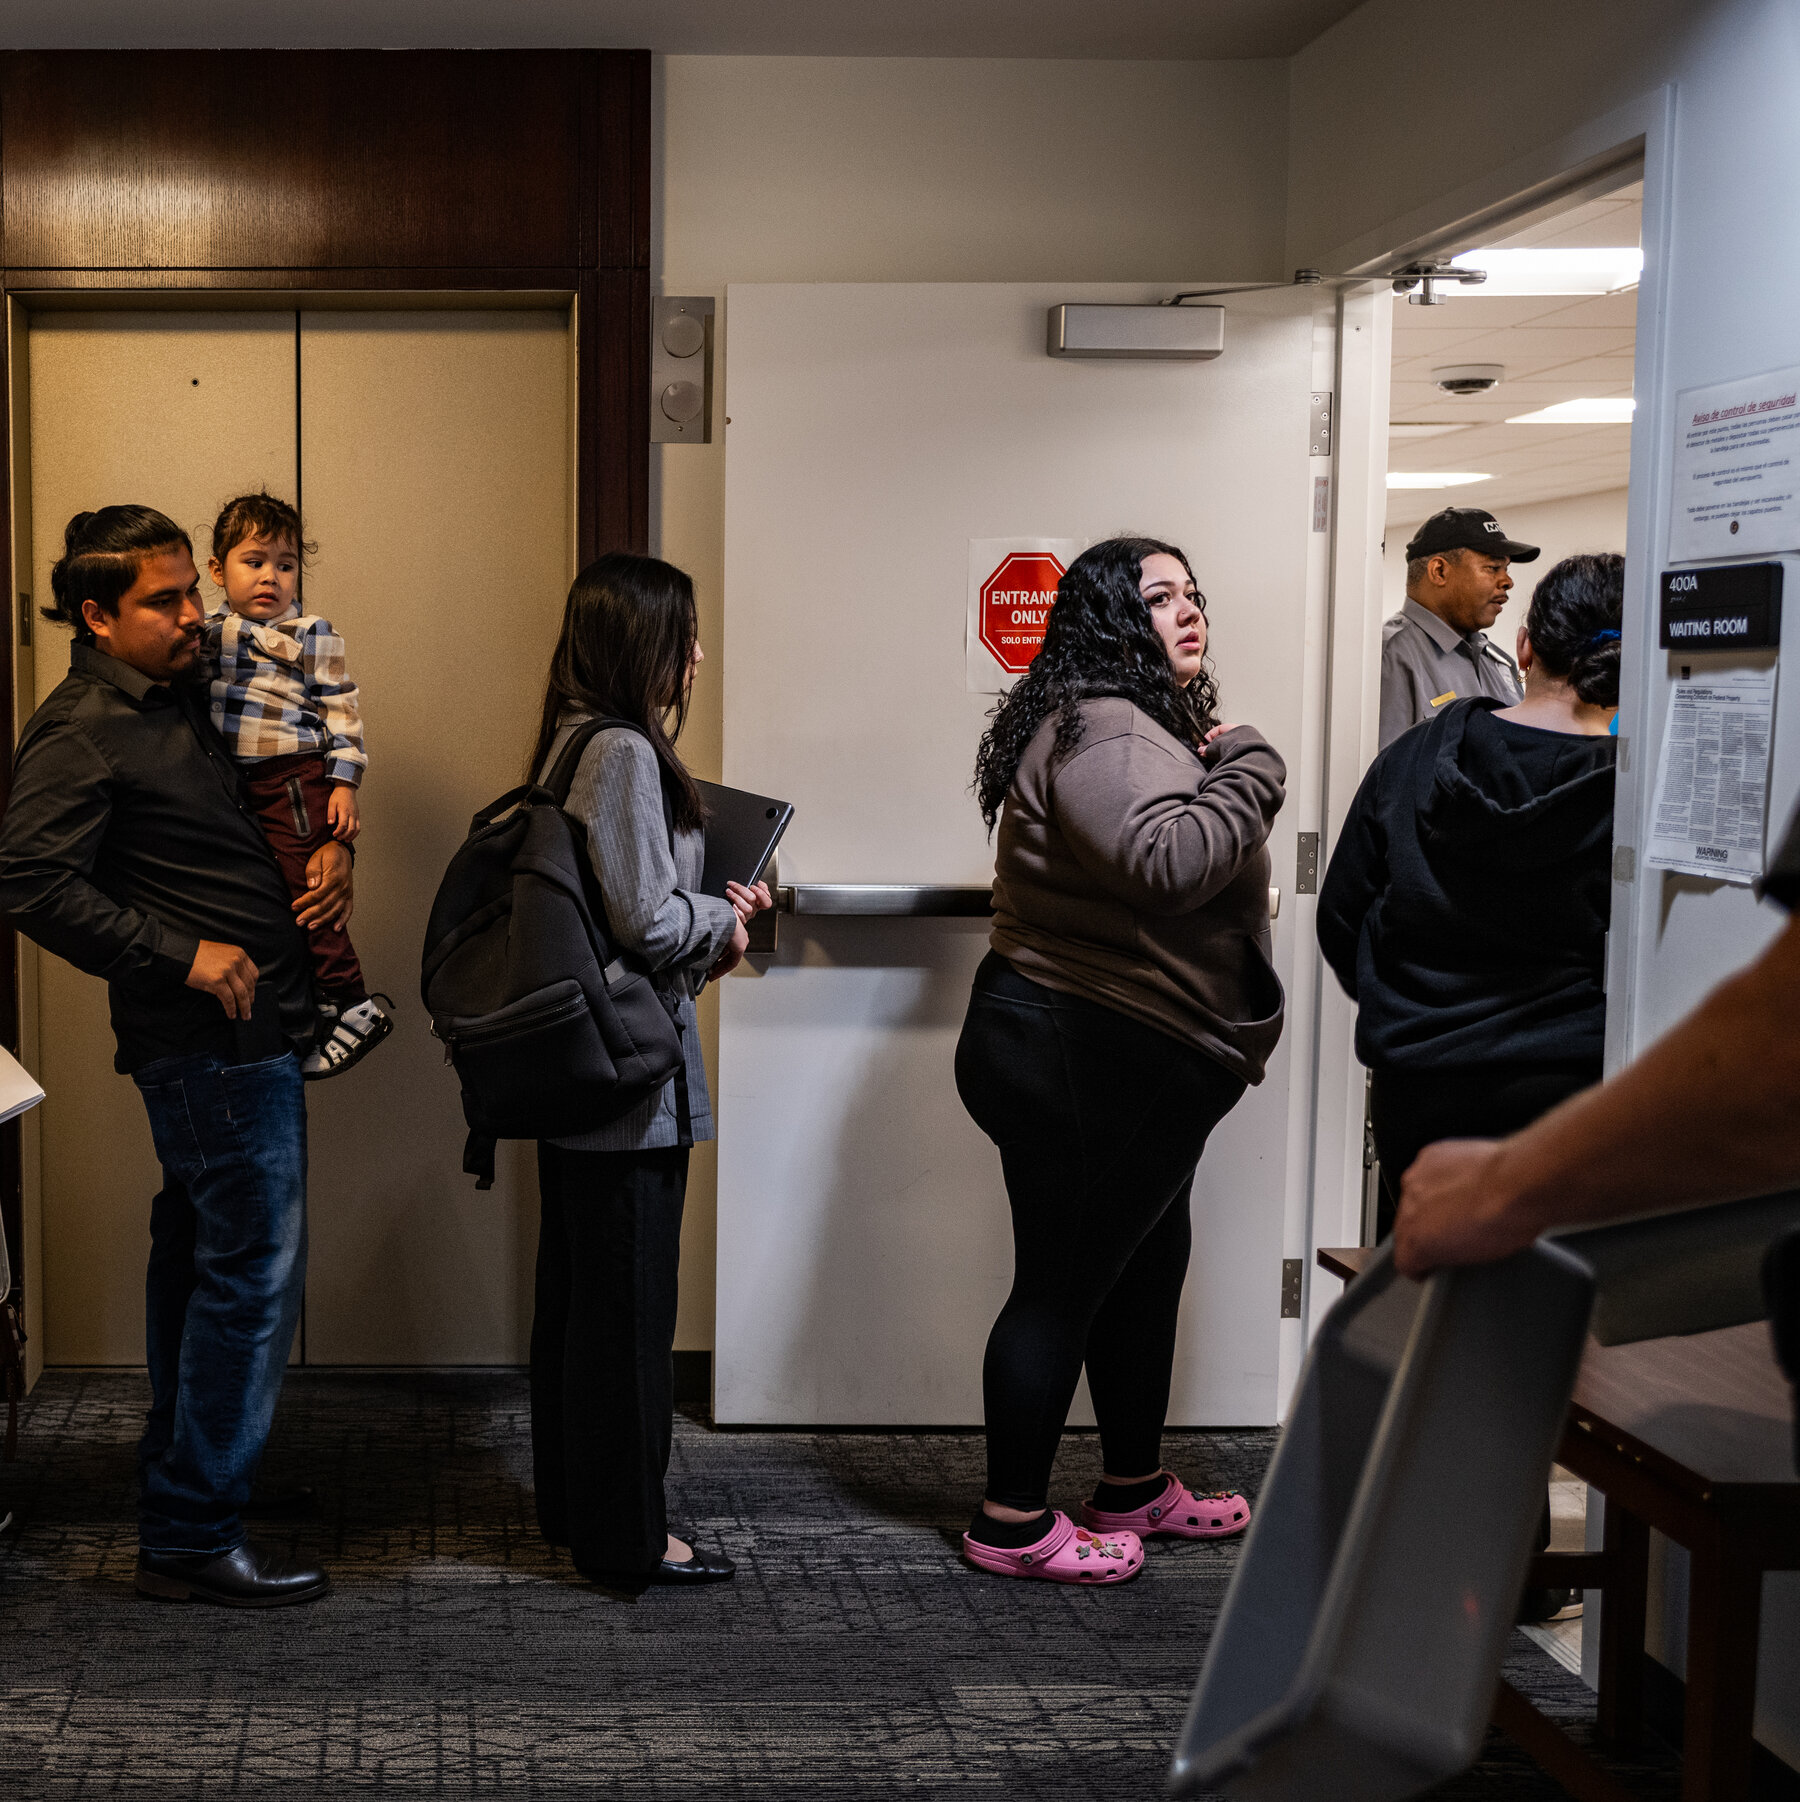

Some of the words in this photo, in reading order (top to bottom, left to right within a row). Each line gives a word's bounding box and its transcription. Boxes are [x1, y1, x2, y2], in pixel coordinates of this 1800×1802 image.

[1692, 412, 1710, 424] Aviso
[1710, 410, 1720, 420] de
[1720, 403, 1746, 417] control
[1747, 401, 1757, 412] de
[1758, 392, 1797, 411] seguridad
[1669, 575, 1698, 592] 400A
[991, 590, 1059, 605] ENTRANC
[1011, 610, 1048, 625] ONLY
[1669, 620, 1710, 637] WAITING
[1713, 616, 1748, 635] ROOM
[1001, 636, 1021, 645] SOLO
[1695, 846, 1728, 859] WARNING
[324, 998, 386, 1066] AIR
